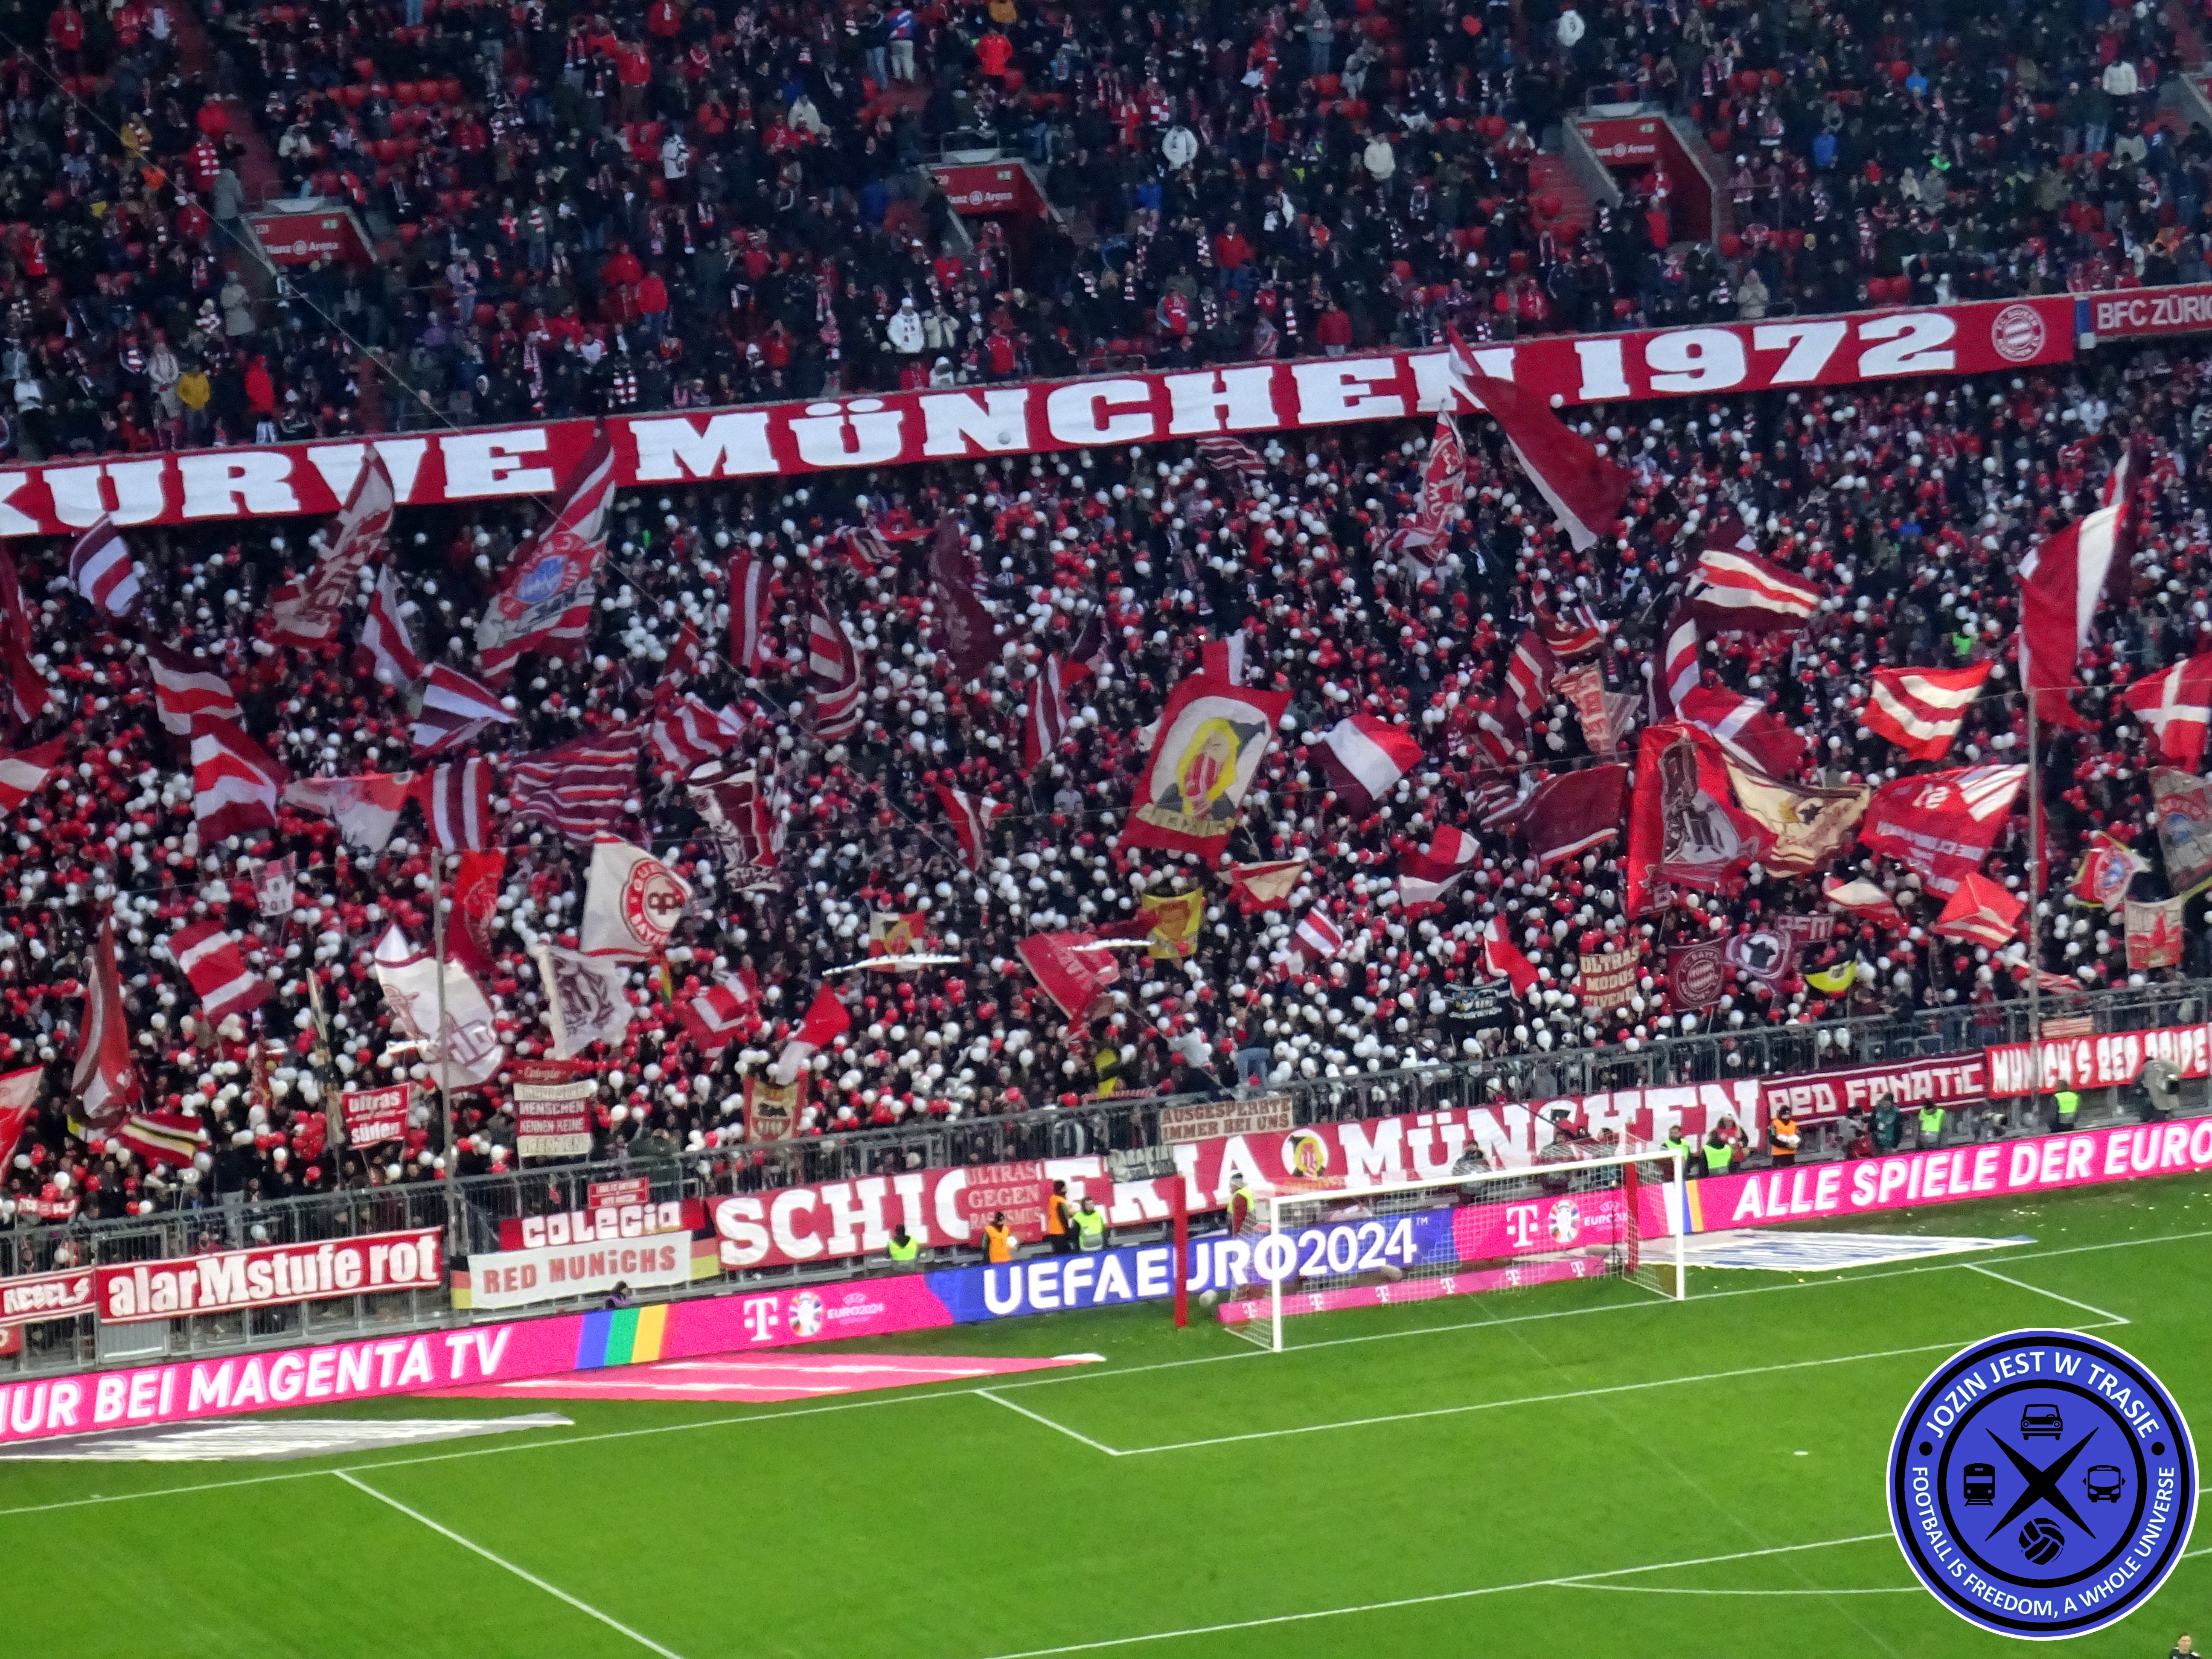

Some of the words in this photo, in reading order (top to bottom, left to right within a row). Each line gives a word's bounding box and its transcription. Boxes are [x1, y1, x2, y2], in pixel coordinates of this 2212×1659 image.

[2097, 299, 2147, 330] BFC
[628, 347, 1516, 482] MÜNCHEN
[1574, 312, 1957, 400] 1972
[1580, 945, 1640, 973] ULTRAS
[2096, 1034, 2139, 1083] RED
[1162, 1121, 1219, 1140] IMMER
[1223, 1116, 1252, 1134] BEI
[1256, 1112, 1291, 1131] UNS
[966, 1162, 1036, 1186] ULTRAS
[1732, 1164, 1844, 1221] ALLE
[1850, 1146, 2001, 1207] SPIELE
[2008, 1135, 2095, 1187] DER
[968, 1184, 1040, 1209] GEGEN
[370, 1234, 437, 1285] rot
[483, 1263, 537, 1294] RED
[3, 1278, 90, 1314] REBELS
[827, 1302, 886, 1319] EURO2024
[0, 1379, 82, 1435] UR
[93, 1367, 176, 1423] BEI
[187, 1338, 434, 1412] MAGENTA
[445, 1325, 513, 1379] TV
